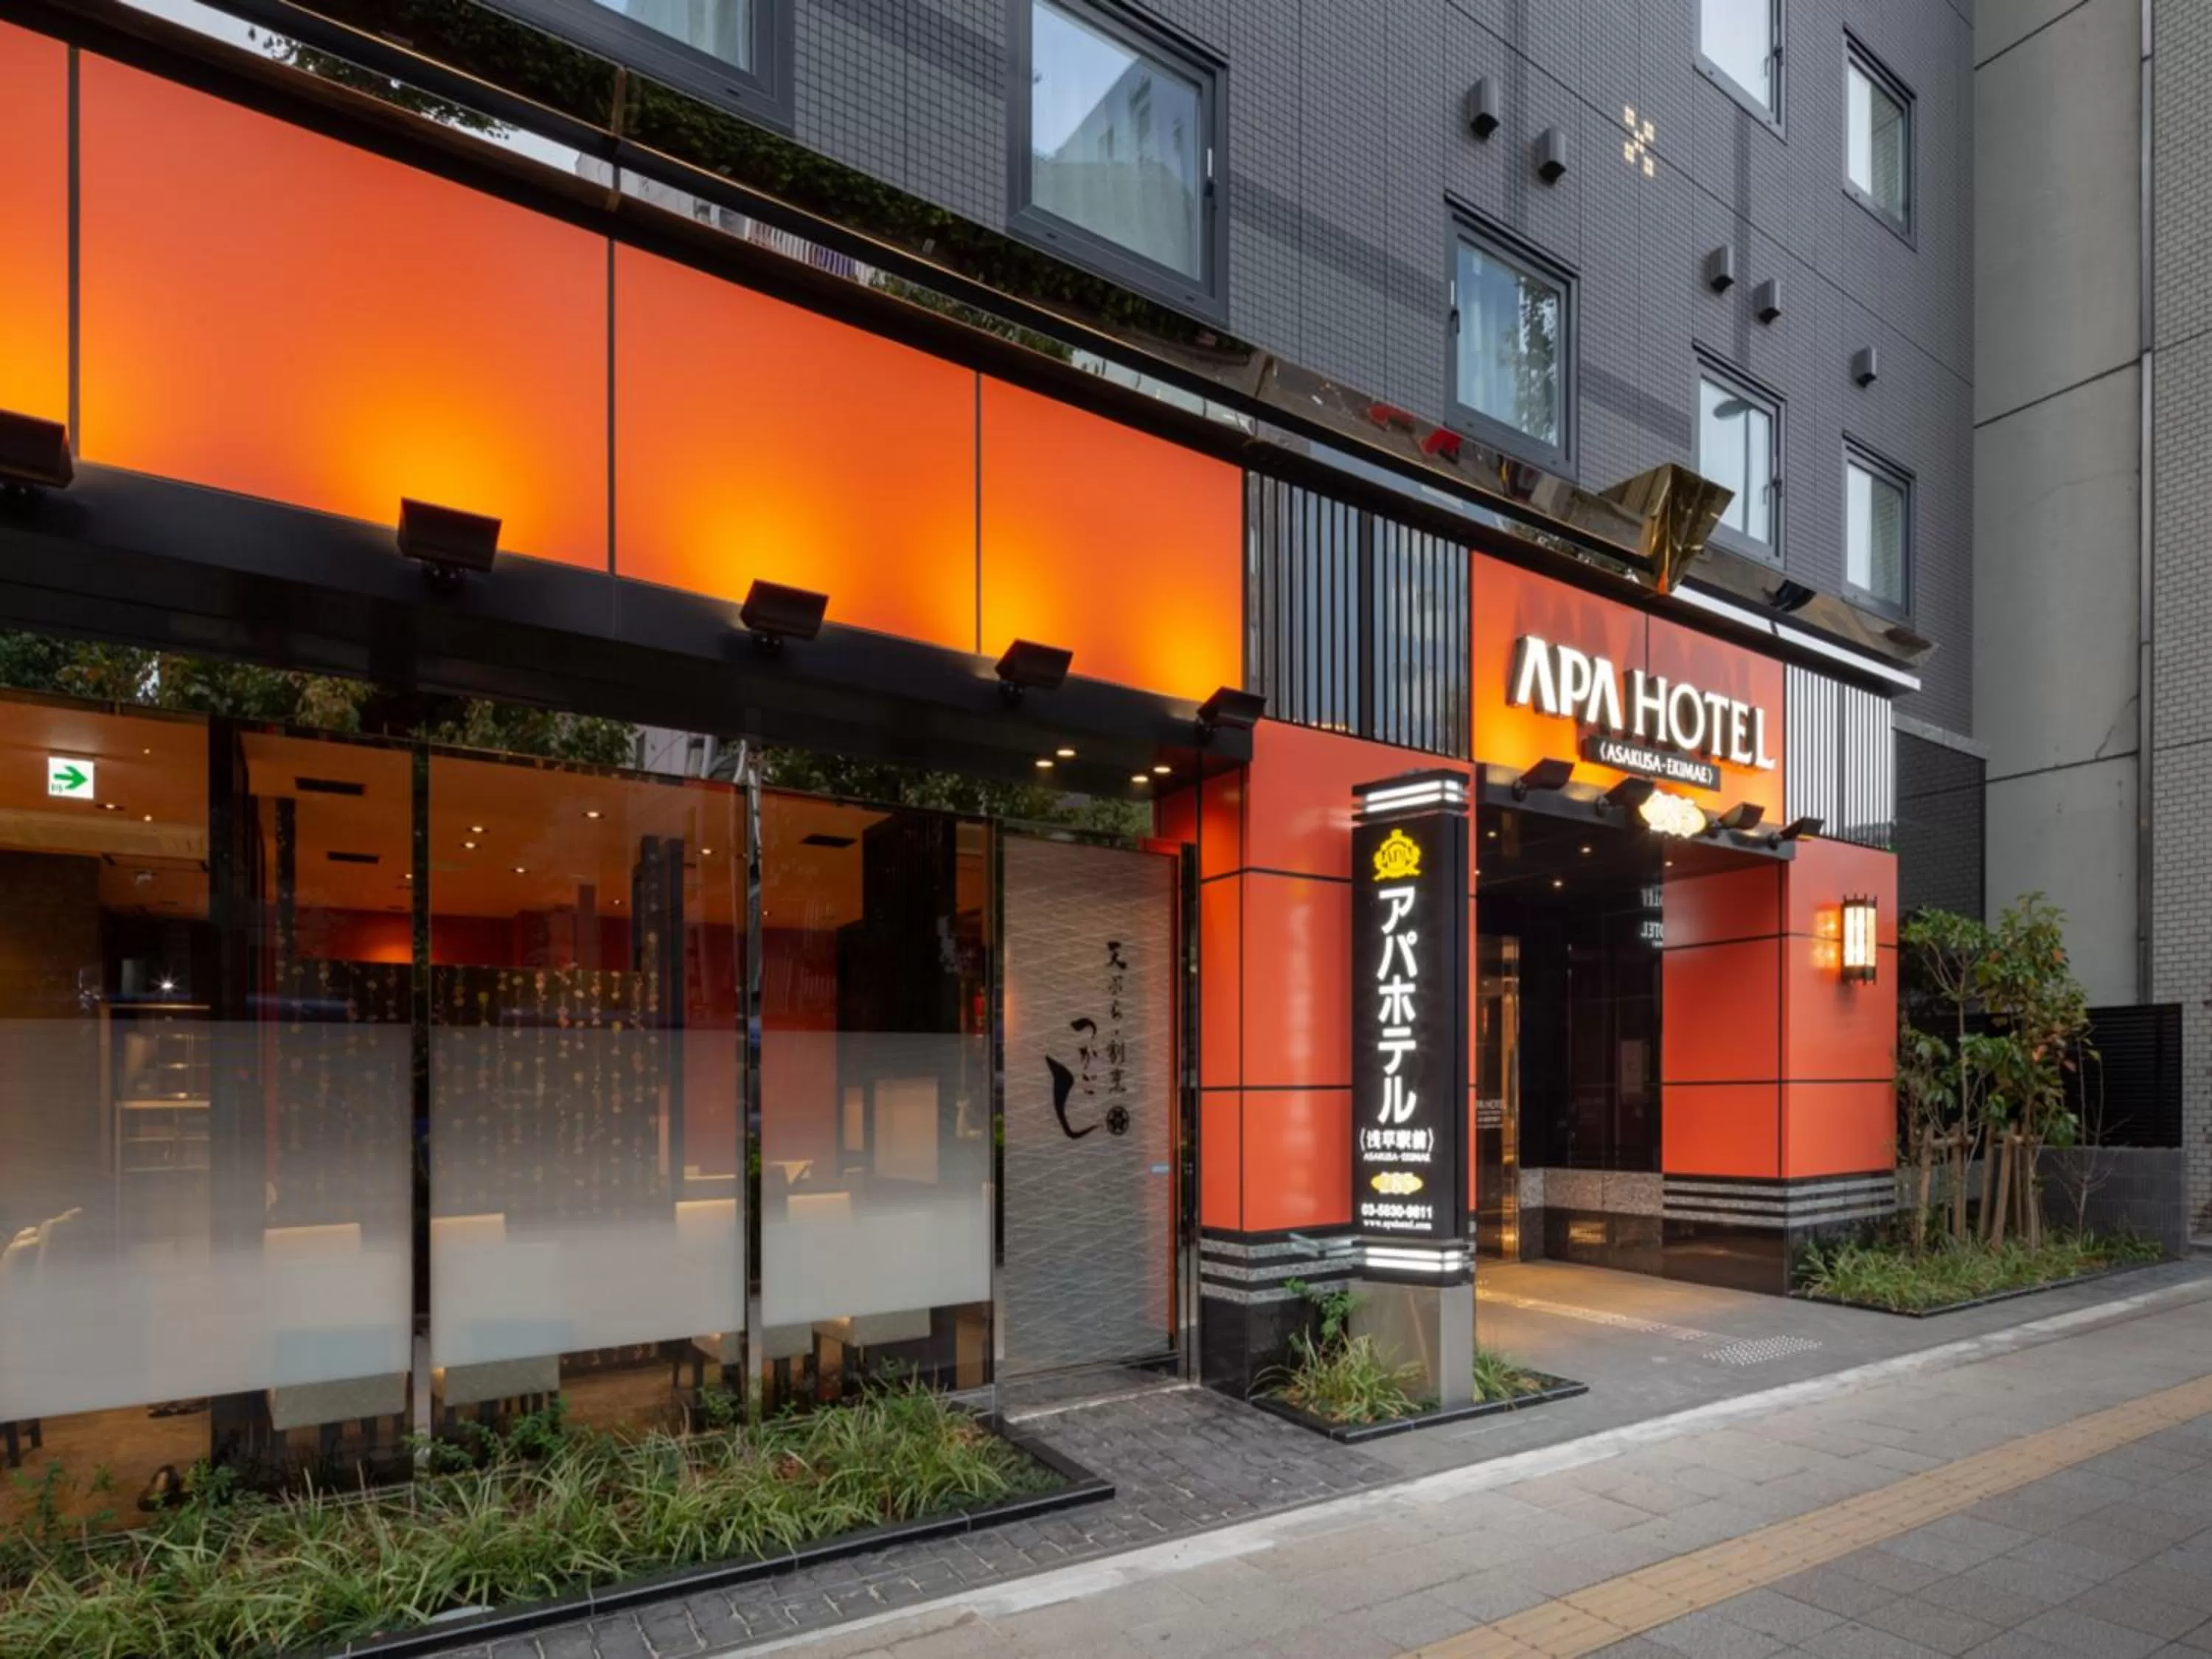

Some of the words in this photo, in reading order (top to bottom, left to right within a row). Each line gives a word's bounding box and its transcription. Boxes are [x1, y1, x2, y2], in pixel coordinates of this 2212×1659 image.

[1516, 634, 1622, 730] APA
[1632, 668, 1776, 770] HOTEL
[1376, 886, 1419, 1125] アパホテル
